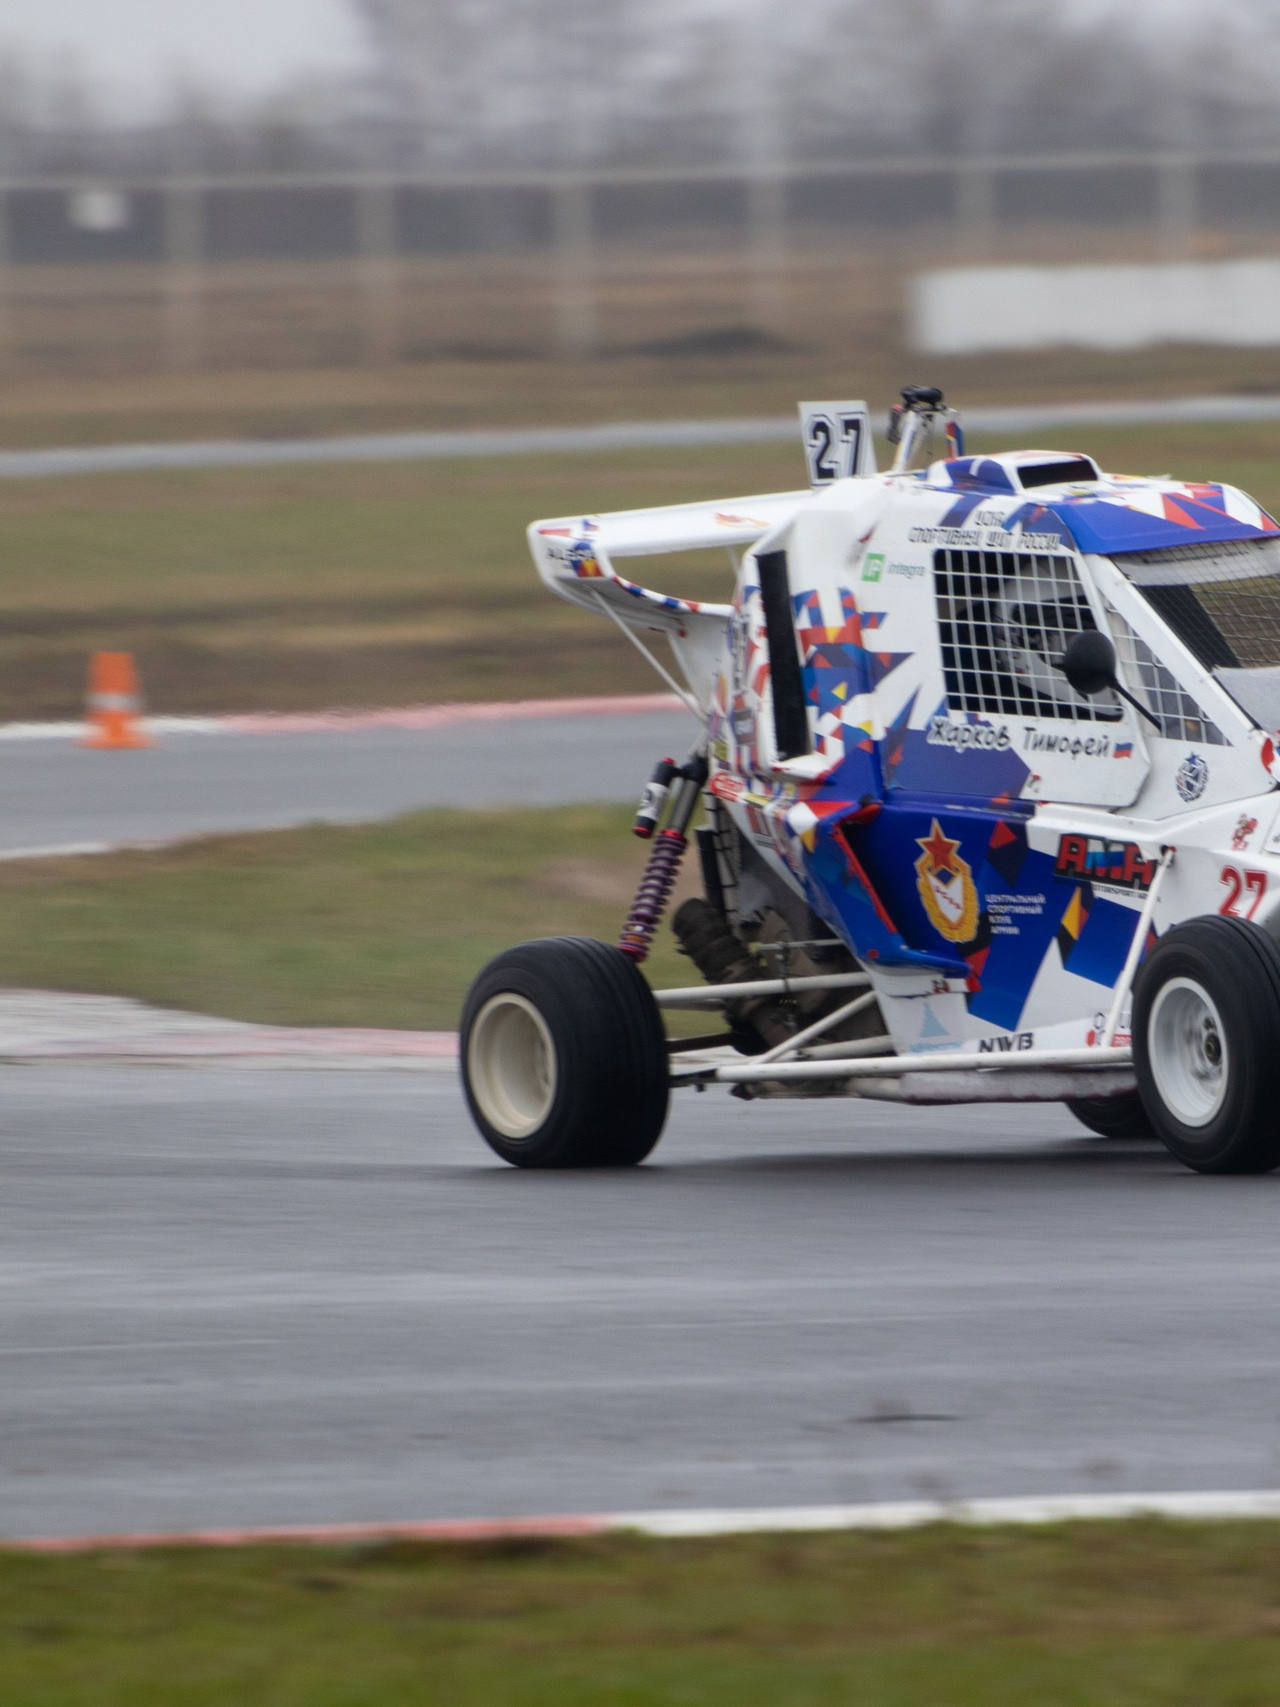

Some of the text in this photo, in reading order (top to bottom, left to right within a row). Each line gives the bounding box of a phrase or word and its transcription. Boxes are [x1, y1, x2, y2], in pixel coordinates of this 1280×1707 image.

[806, 412, 866, 486] 27
[929, 717, 1111, 760] Жарков Тимофей
[1218, 864, 1268, 920] 27
[979, 1032, 1034, 1053] NWB
